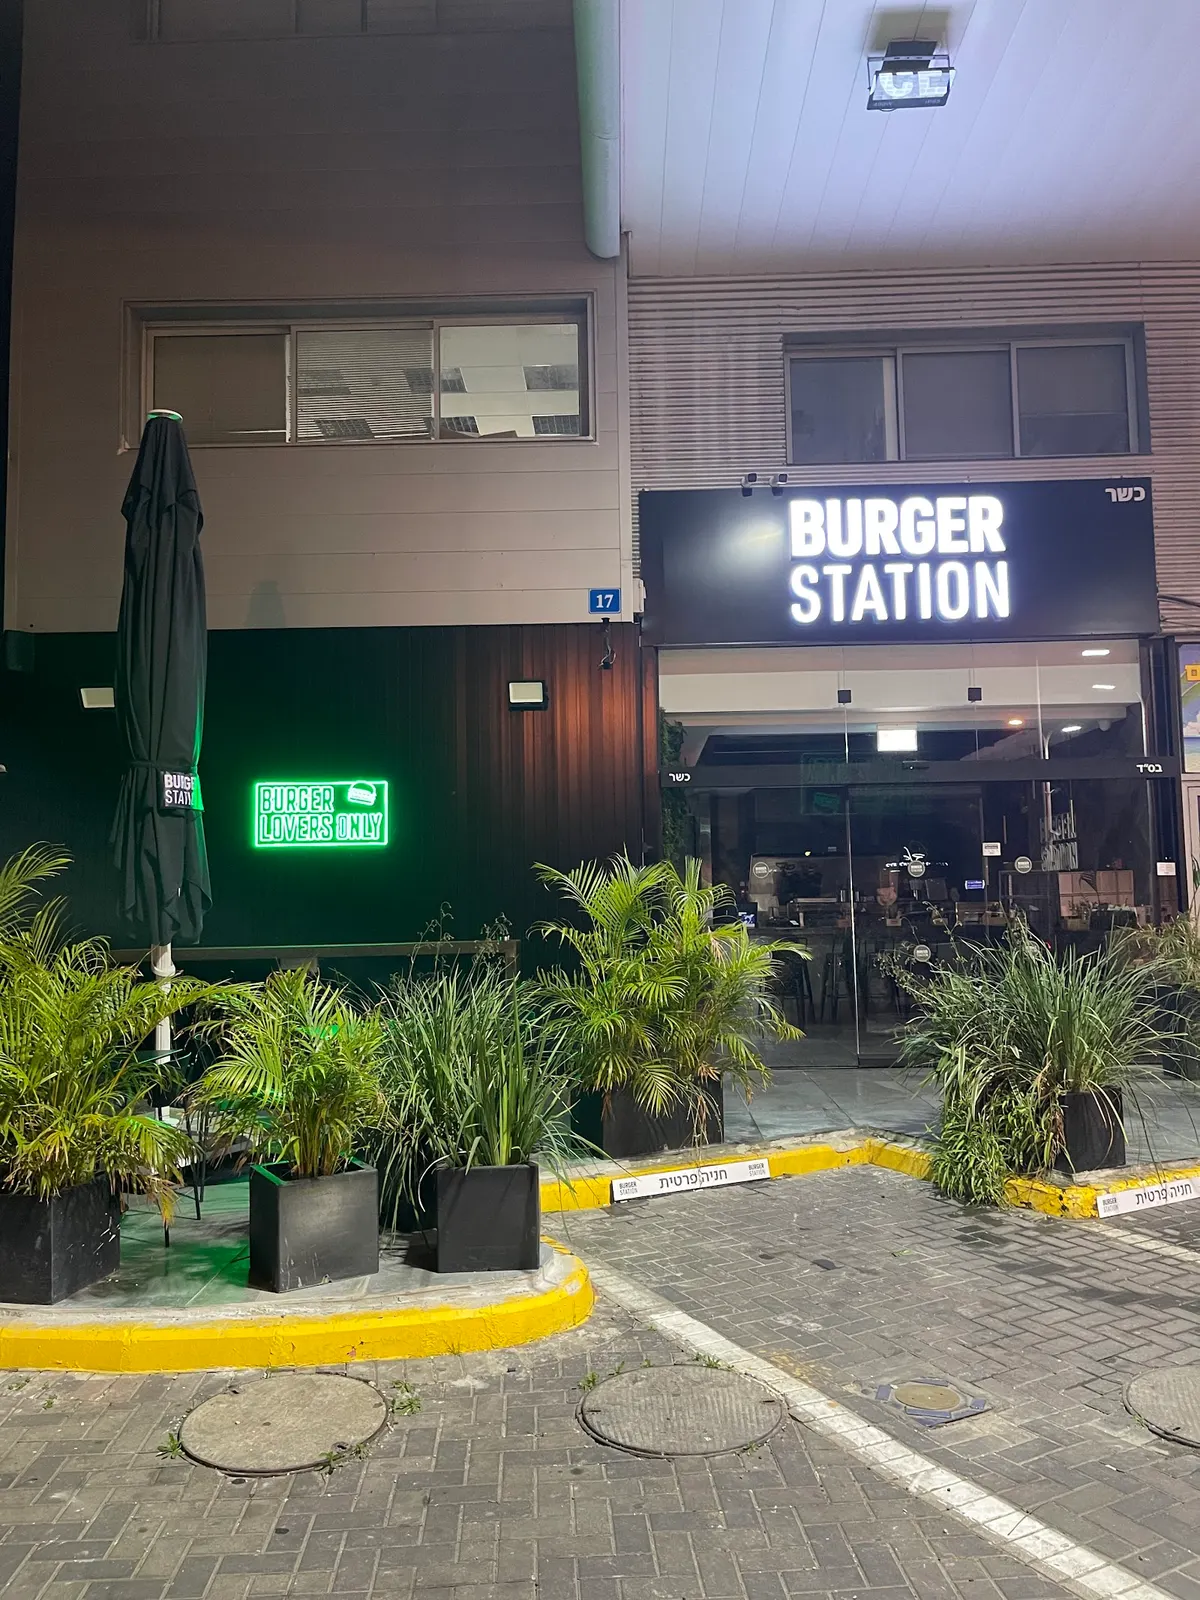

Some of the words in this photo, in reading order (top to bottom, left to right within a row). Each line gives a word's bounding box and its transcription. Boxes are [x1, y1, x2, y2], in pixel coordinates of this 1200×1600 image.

[1105, 486, 1146, 503] כשר
[790, 496, 1006, 557] BURGER
[790, 560, 1010, 624] STATION
[596, 594, 614, 608] 17
[668, 773, 691, 782] כשר
[260, 786, 334, 813] BURGER
[260, 814, 334, 842] LOVERS
[336, 812, 383, 841] ONLY
[701, 1168, 728, 1183] חניה
[748, 1163, 765, 1171] BURGER
[619, 1181, 637, 1189] BURGER
[659, 1172, 698, 1189] פרטית
[1135, 1188, 1168, 1206] פרטית
[1169, 1183, 1193, 1198] חניה
